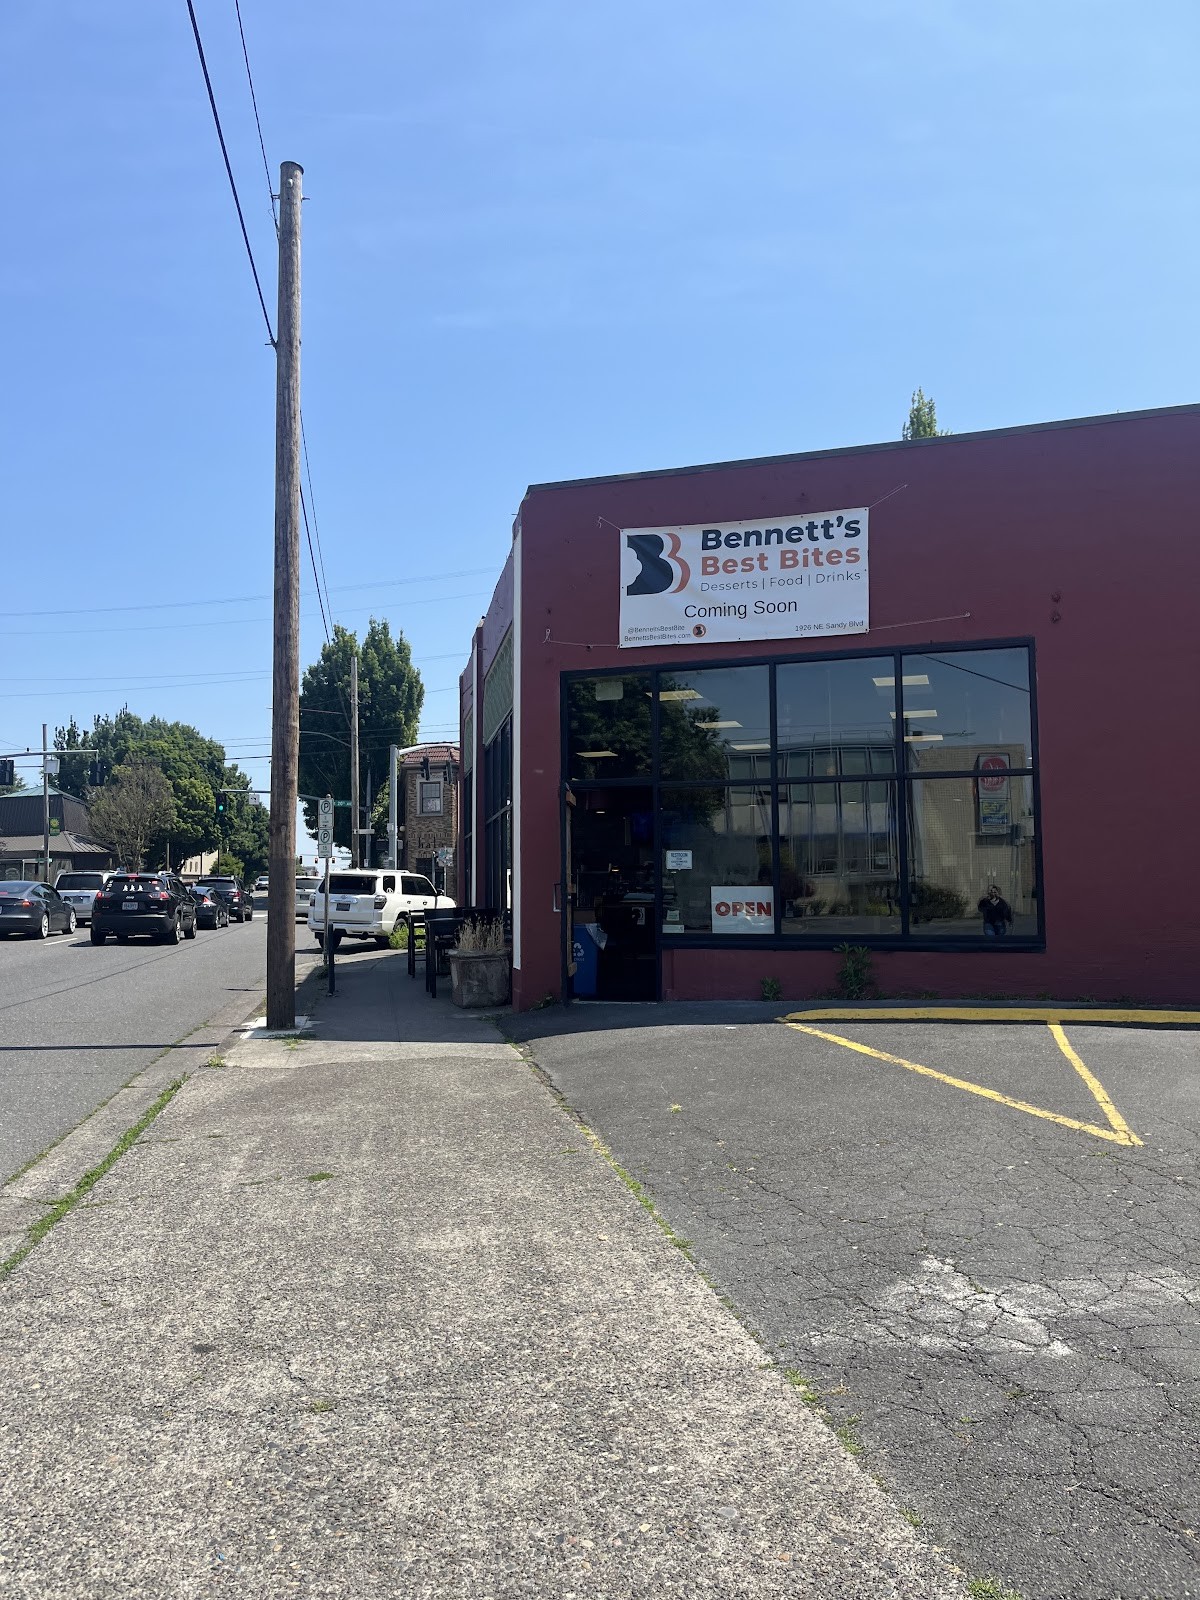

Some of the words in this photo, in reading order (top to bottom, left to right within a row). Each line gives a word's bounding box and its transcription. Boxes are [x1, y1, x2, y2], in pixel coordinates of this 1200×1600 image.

[702, 515, 861, 551] Bennett's
[701, 552, 769, 576] Best
[779, 547, 861, 570] Bites
[700, 578, 758, 592] Desserts
[770, 575, 803, 587] Food
[815, 570, 861, 584] Drinks
[684, 602, 747, 619] Coming
[753, 600, 798, 614] Soon
[795, 624, 812, 632] 1926
[825, 622, 847, 630] Sandy
[848, 620, 864, 628] Blvd
[715, 901, 772, 917] OPEN
